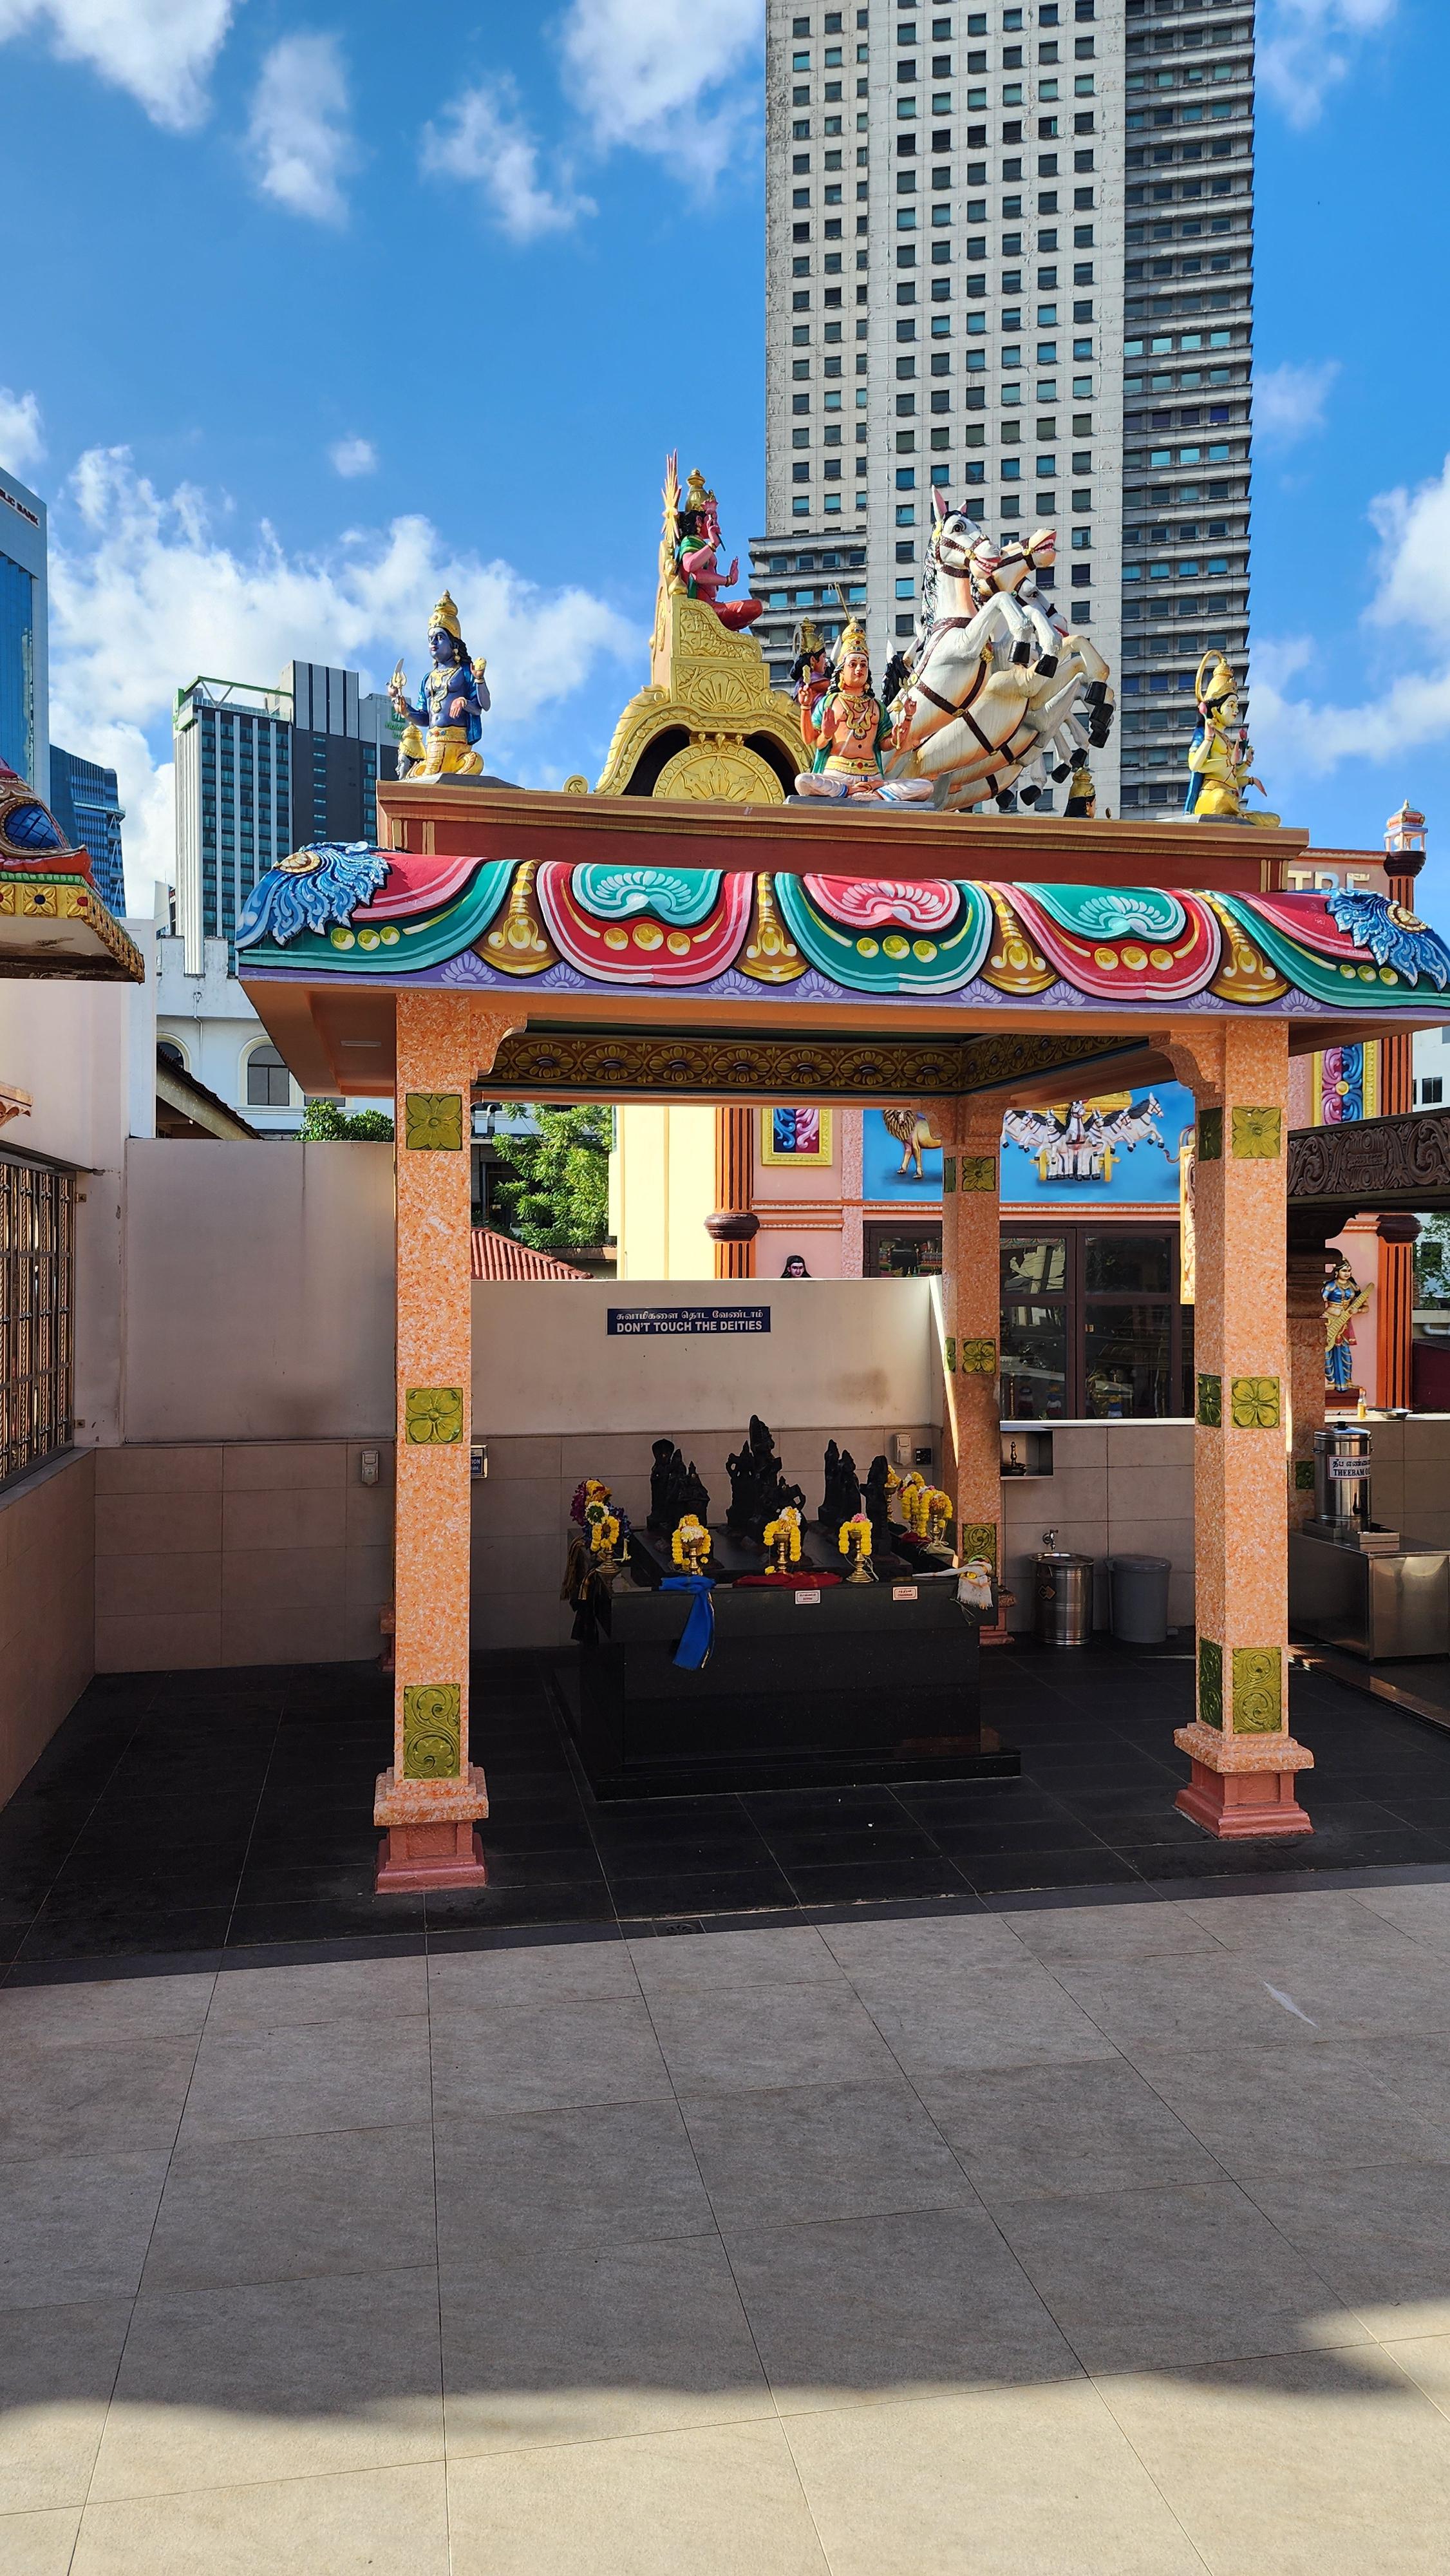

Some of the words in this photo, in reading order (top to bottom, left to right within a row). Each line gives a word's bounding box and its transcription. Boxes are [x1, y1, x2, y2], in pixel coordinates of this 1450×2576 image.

[681, 1311, 709, 1320] தொட
[617, 1322, 650, 1332] DON'T
[654, 1321, 692, 1331] TOUCH
[695, 1321, 717, 1331] THE
[720, 1320, 762, 1331] DEITIES
[1333, 1468, 1364, 1477] THEEBAM
